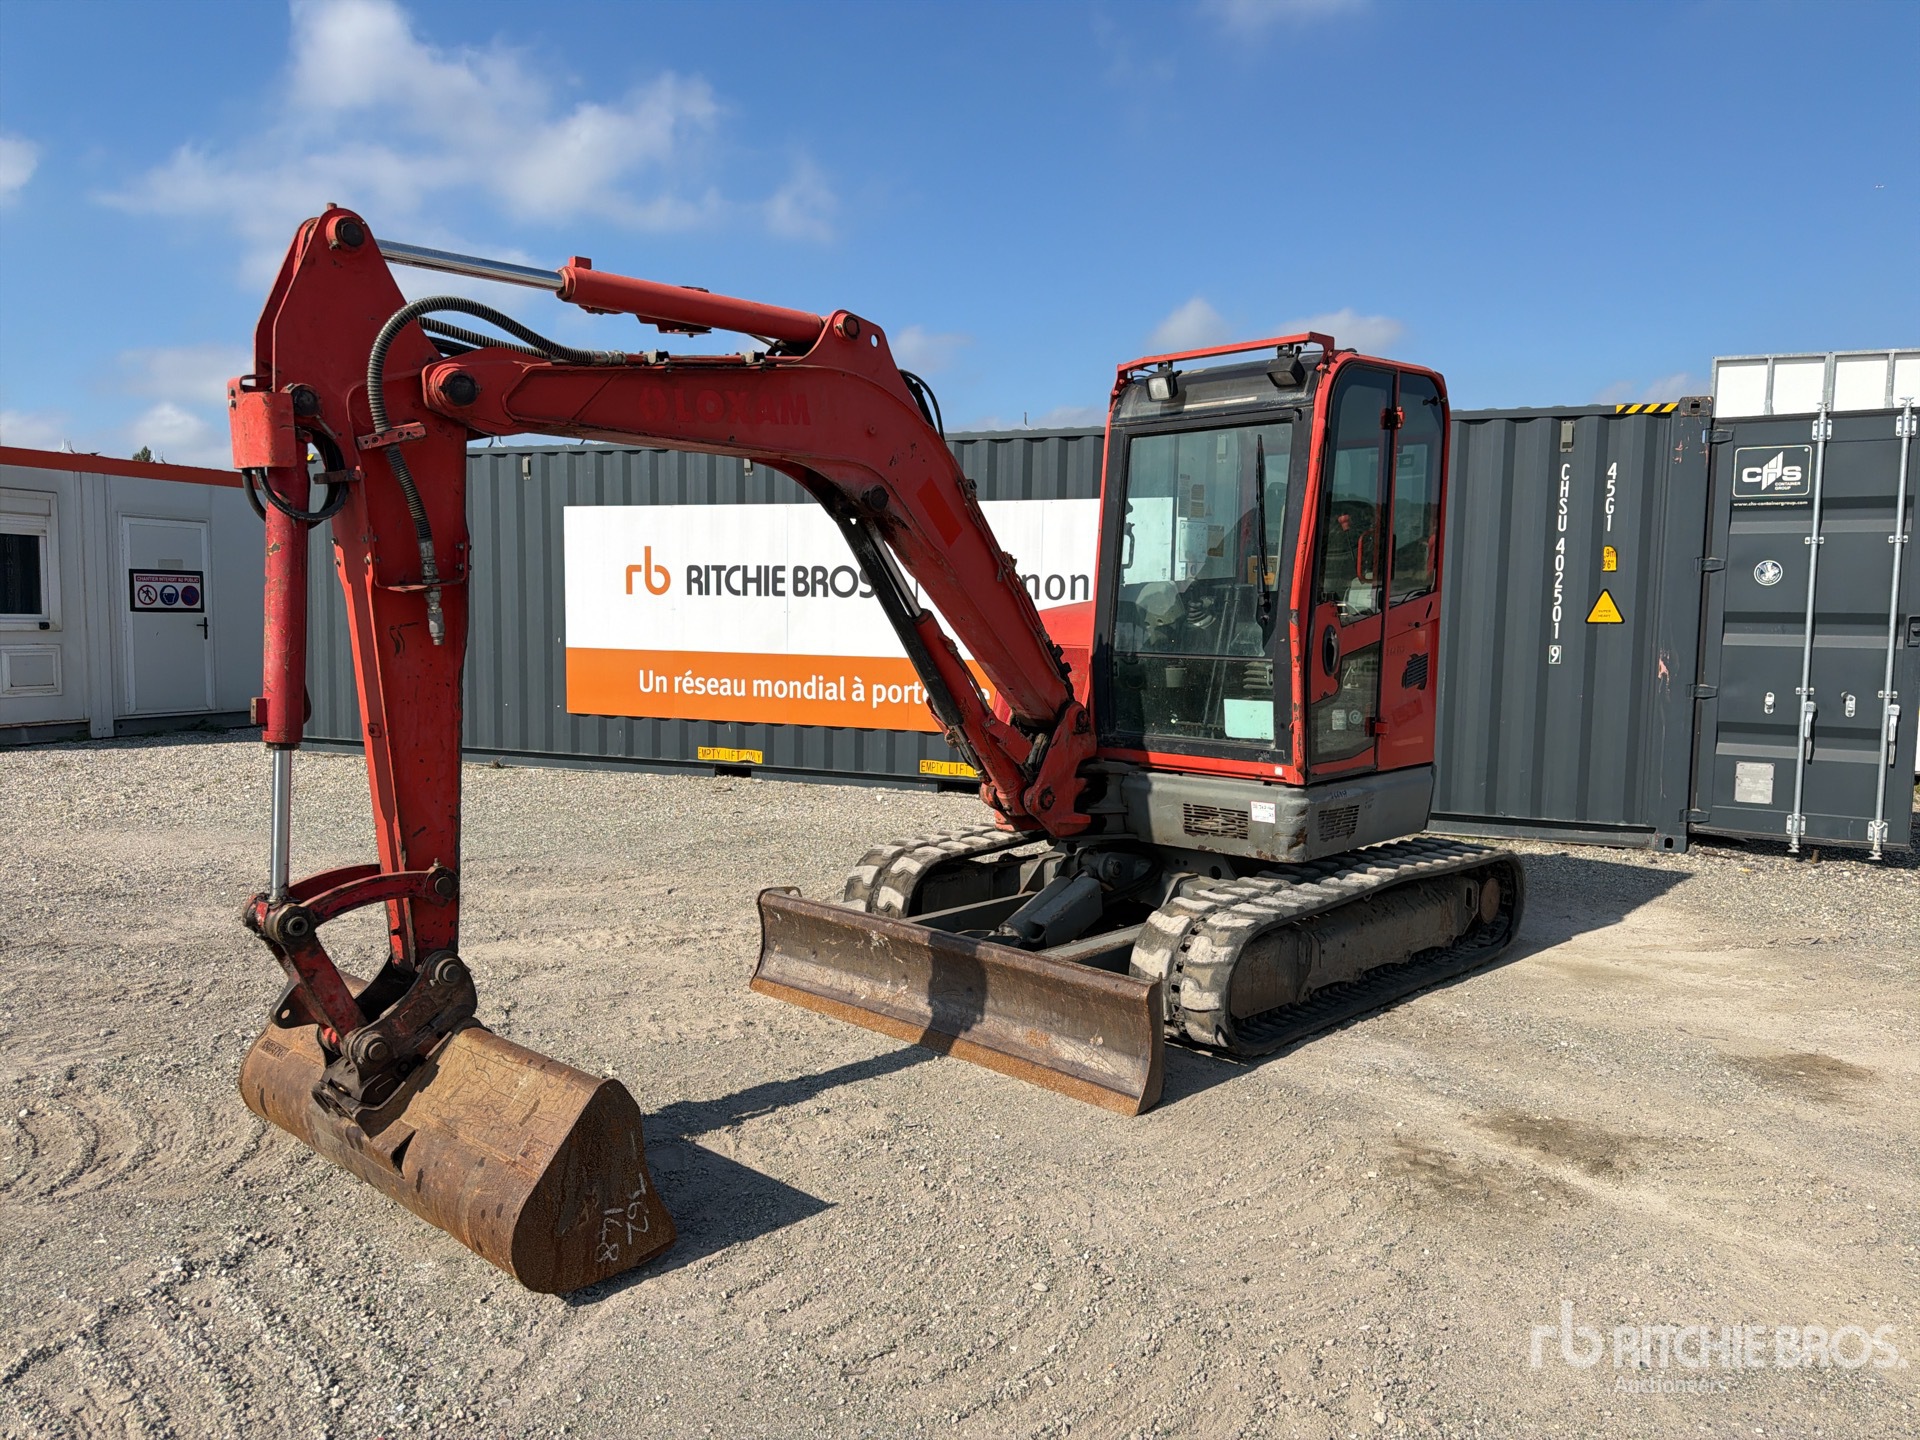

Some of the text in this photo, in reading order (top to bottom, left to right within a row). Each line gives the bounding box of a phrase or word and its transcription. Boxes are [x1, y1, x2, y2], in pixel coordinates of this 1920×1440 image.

[674, 388, 811, 425] LOXAM
[1742, 451, 1802, 491] CHS
[1605, 462, 1617, 532] 45G1
[626, 546, 671, 596] rb
[686, 564, 786, 597] RITCHIE
[1550, 463, 1570, 663] CHSU 402501 9
[640, 669, 667, 693] Un
[674, 669, 746, 696] réseau
[753, 675, 846, 701] mondial
[852, 676, 865, 702] à
[921, 761, 943, 773] EMPTY
[948, 764, 968, 775] LIFT
